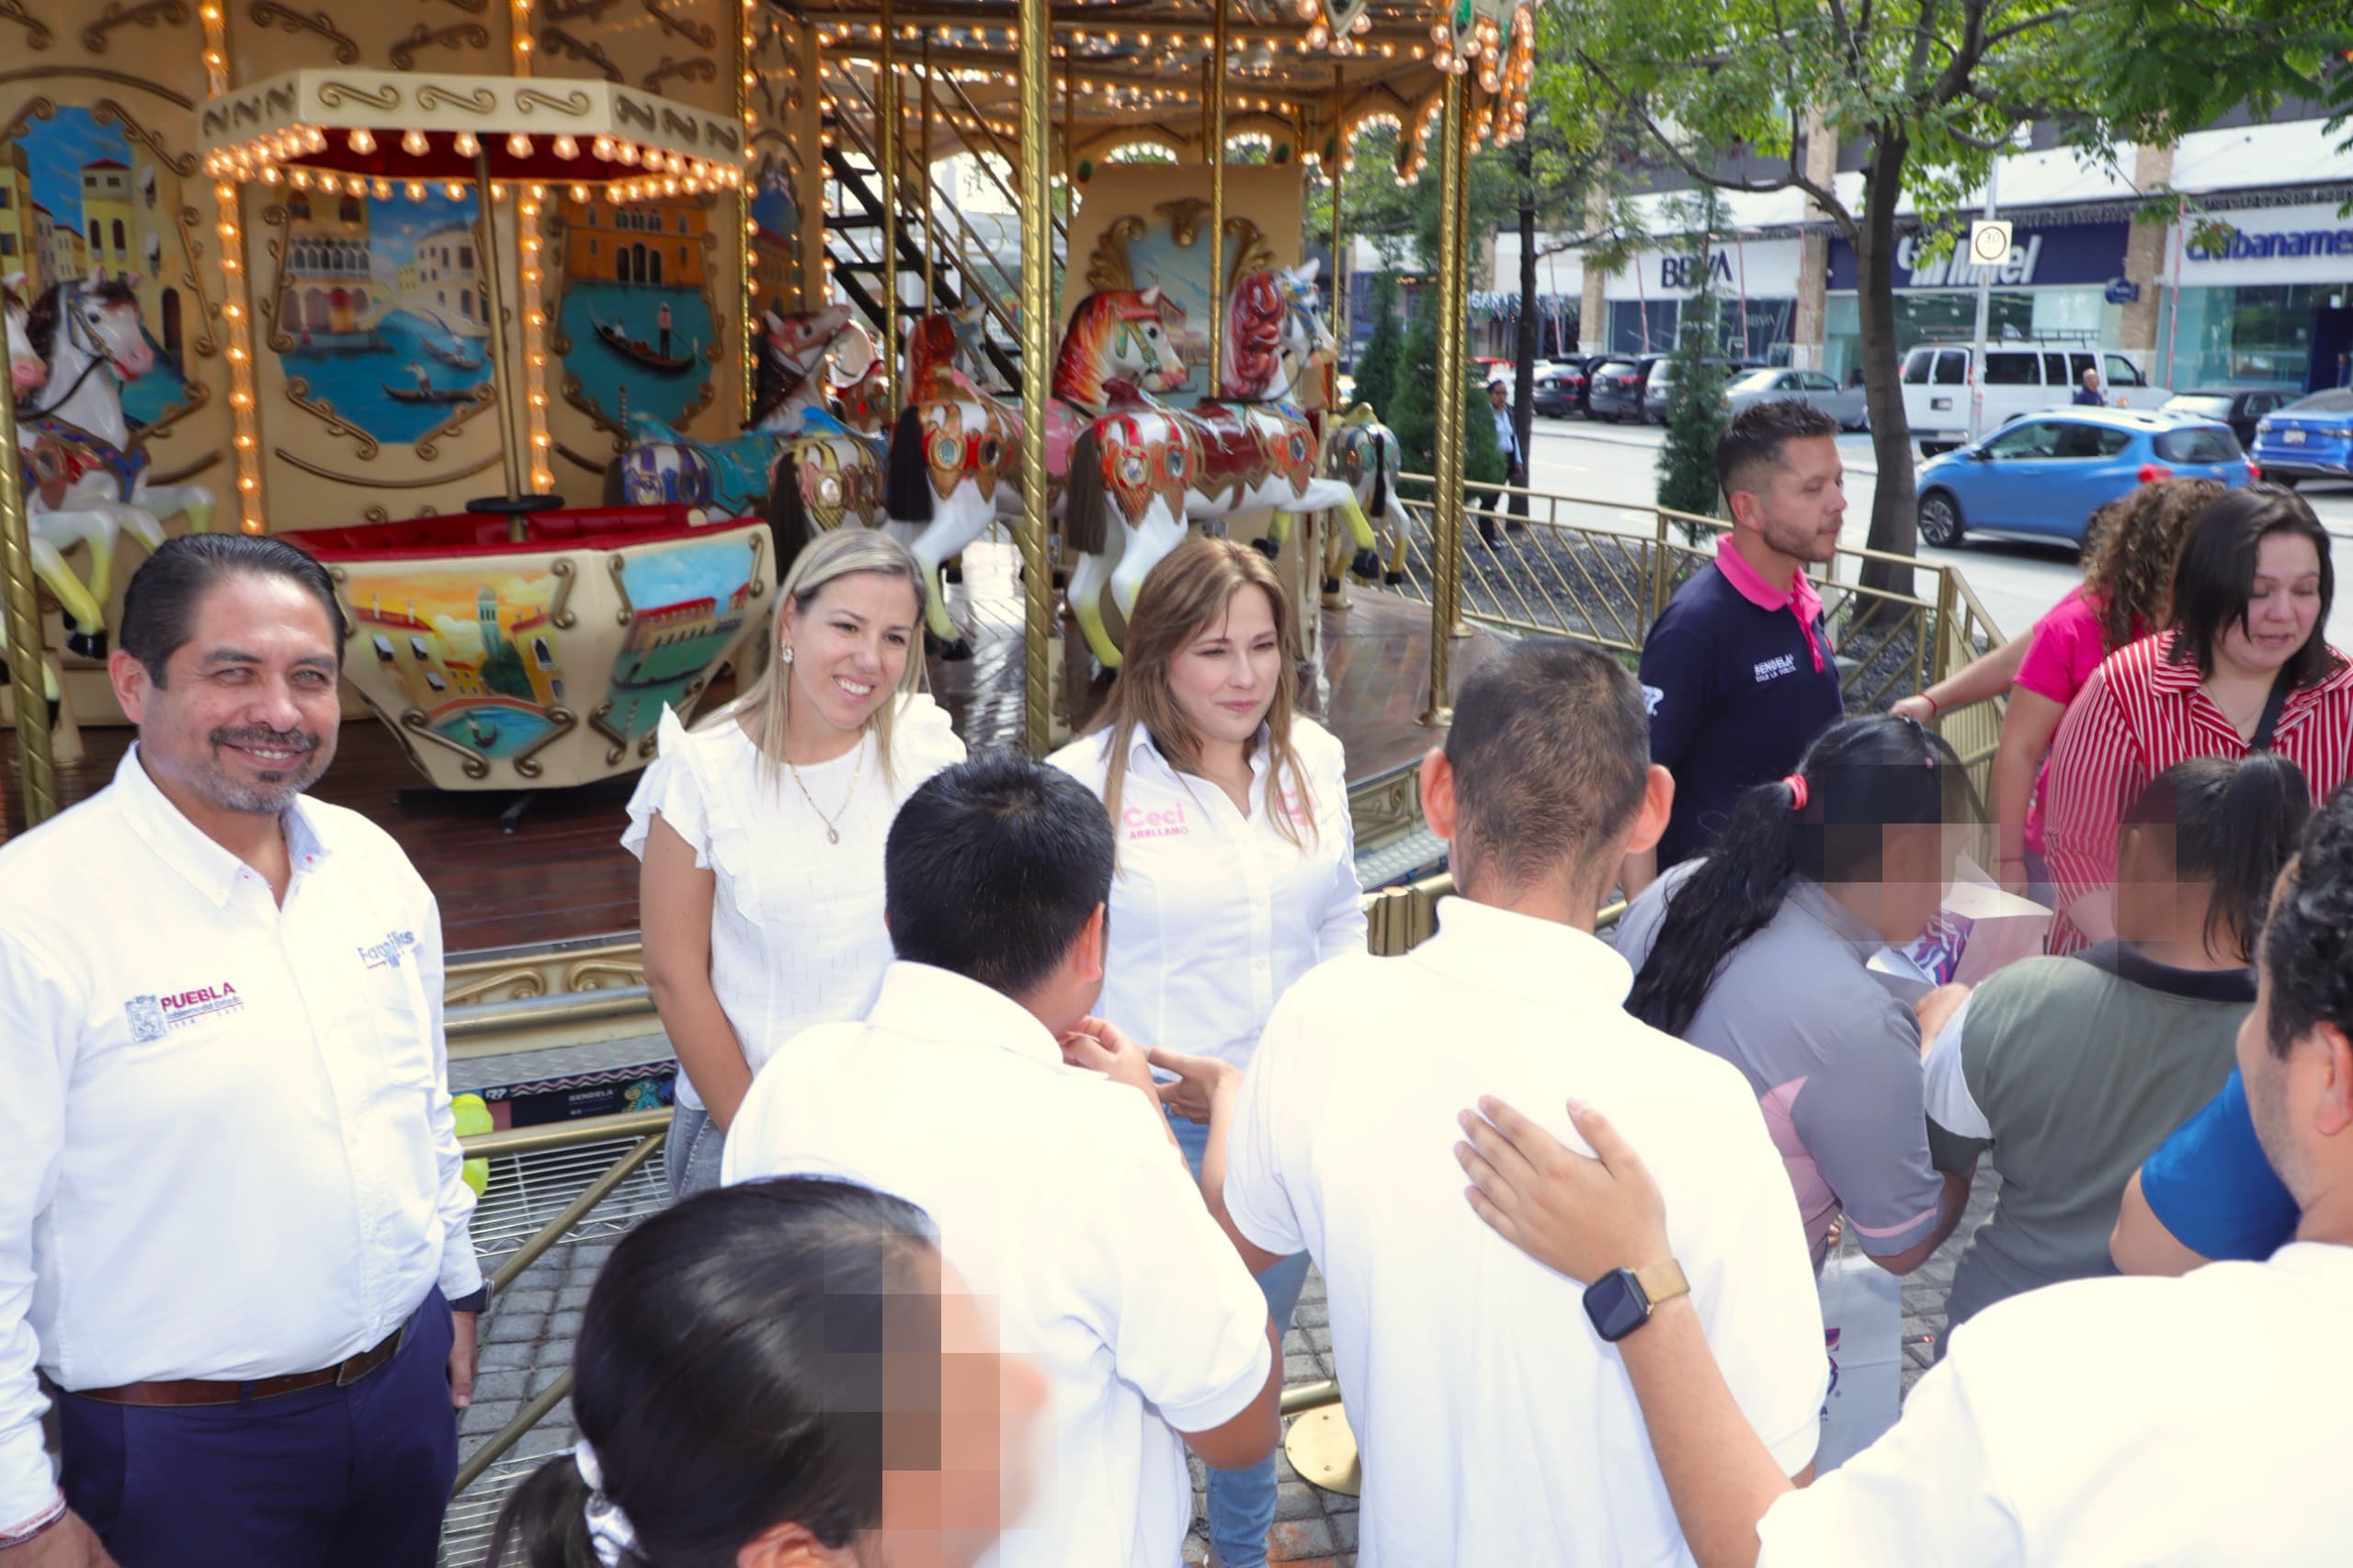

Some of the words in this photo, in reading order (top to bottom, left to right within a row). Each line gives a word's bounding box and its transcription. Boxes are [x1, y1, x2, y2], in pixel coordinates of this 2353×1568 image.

[1985, 232, 2001, 244] 30
[1123, 801, 1185, 827] Ceci
[160, 981, 237, 1013] PUEBLA
